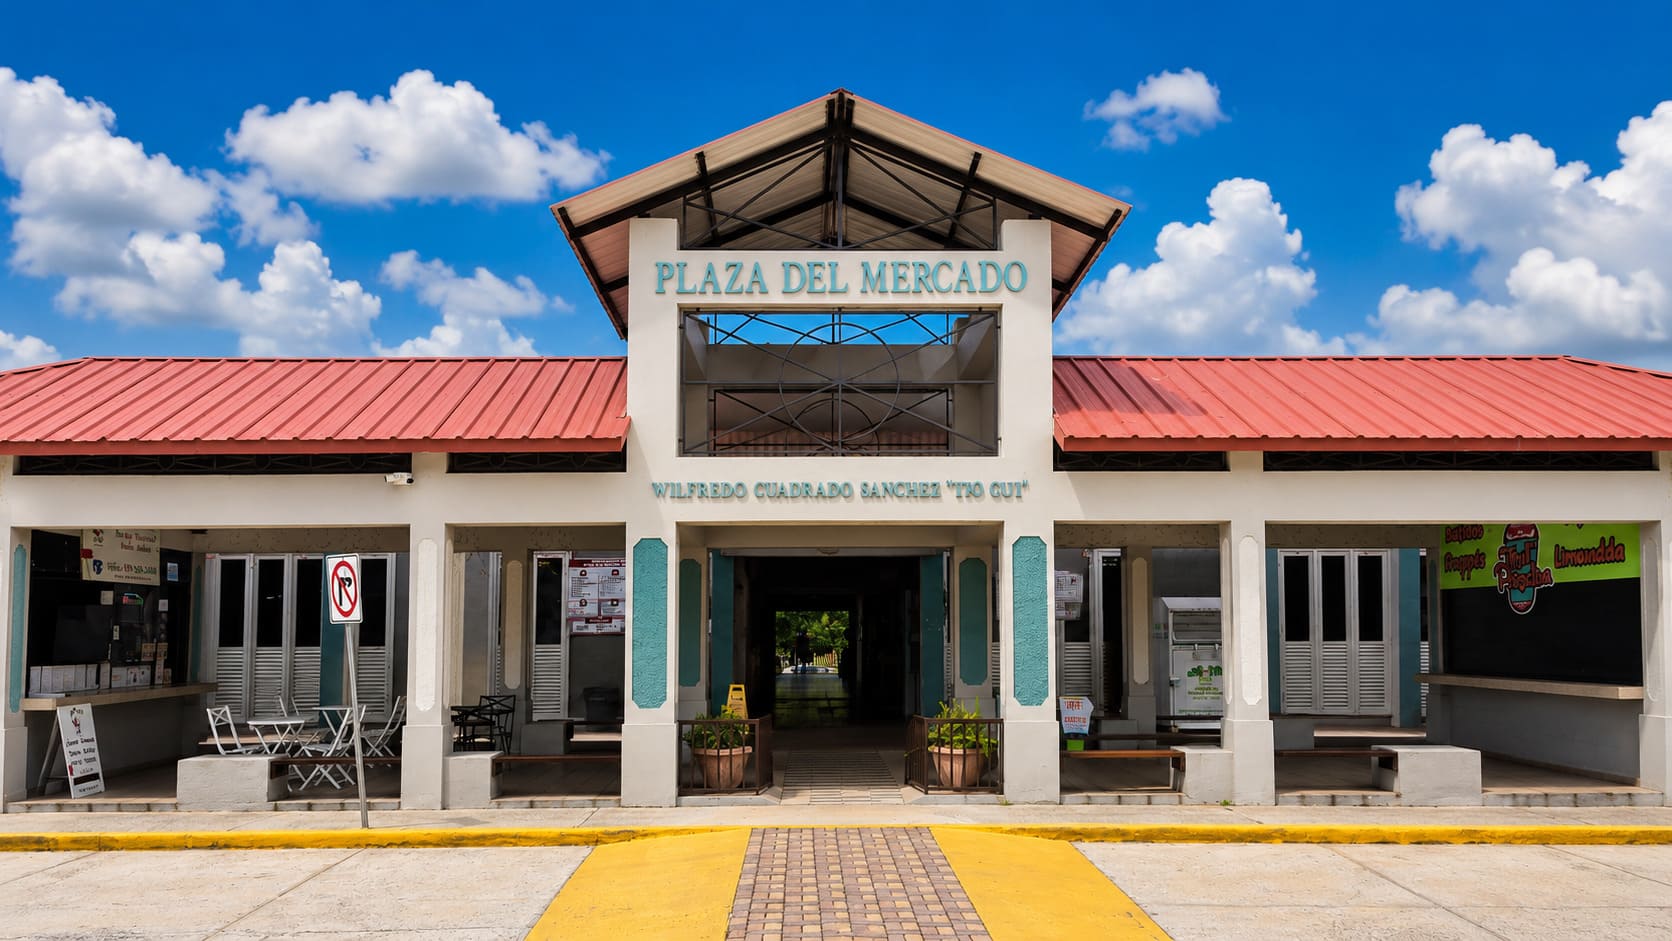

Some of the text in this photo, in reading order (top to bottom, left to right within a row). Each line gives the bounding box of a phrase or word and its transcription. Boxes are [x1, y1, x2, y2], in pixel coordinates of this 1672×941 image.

[655, 260, 1028, 294] PLAZA DEL MERCADO
[652, 482, 748, 498] WILFREDO
[753, 482, 854, 498] CUADRADO
[860, 481, 941, 498] SANCHEZ
